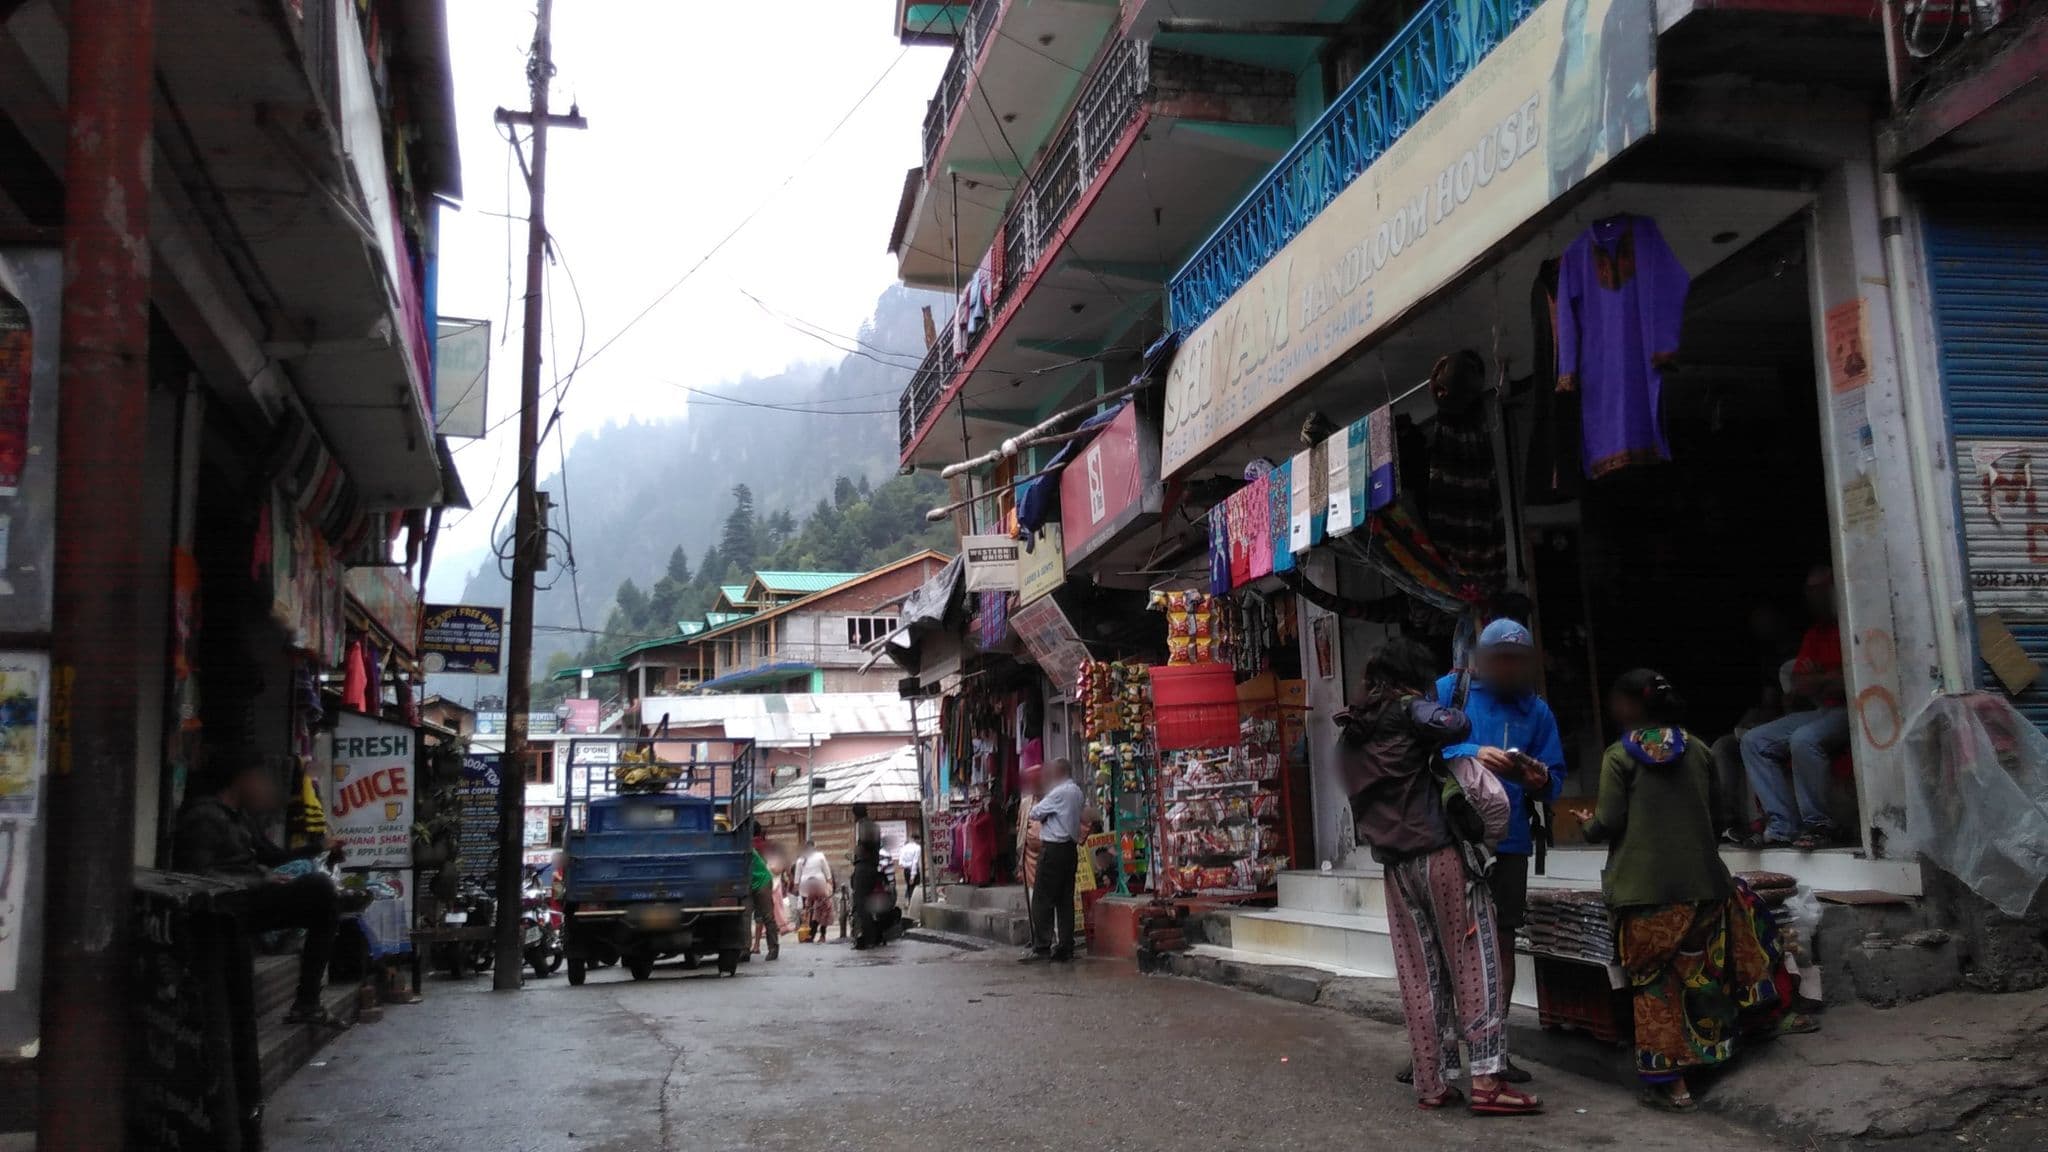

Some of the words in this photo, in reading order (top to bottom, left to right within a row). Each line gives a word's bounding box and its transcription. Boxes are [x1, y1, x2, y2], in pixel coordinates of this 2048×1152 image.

[1165, 256, 1292, 437] SHIVAM
[1300, 184, 1431, 332] HANDLOOM
[1433, 92, 1540, 226] HOUSE
[1325, 287, 1374, 351] SHAWLS
[969, 548, 1010, 557] WESTERN
[982, 553, 1010, 561] UNION
[1976, 572, 2048, 588] BREAK
[460, 607, 482, 618] FREE
[332, 735, 408, 758] FRESH
[484, 767, 500, 786] TOP
[332, 767, 409, 817] JUICE
[471, 786, 499, 795] COFFEE
[377, 824, 404, 834] SHAKE
[379, 833, 408, 844] SHAKE
[357, 848, 382, 857] APPLE
